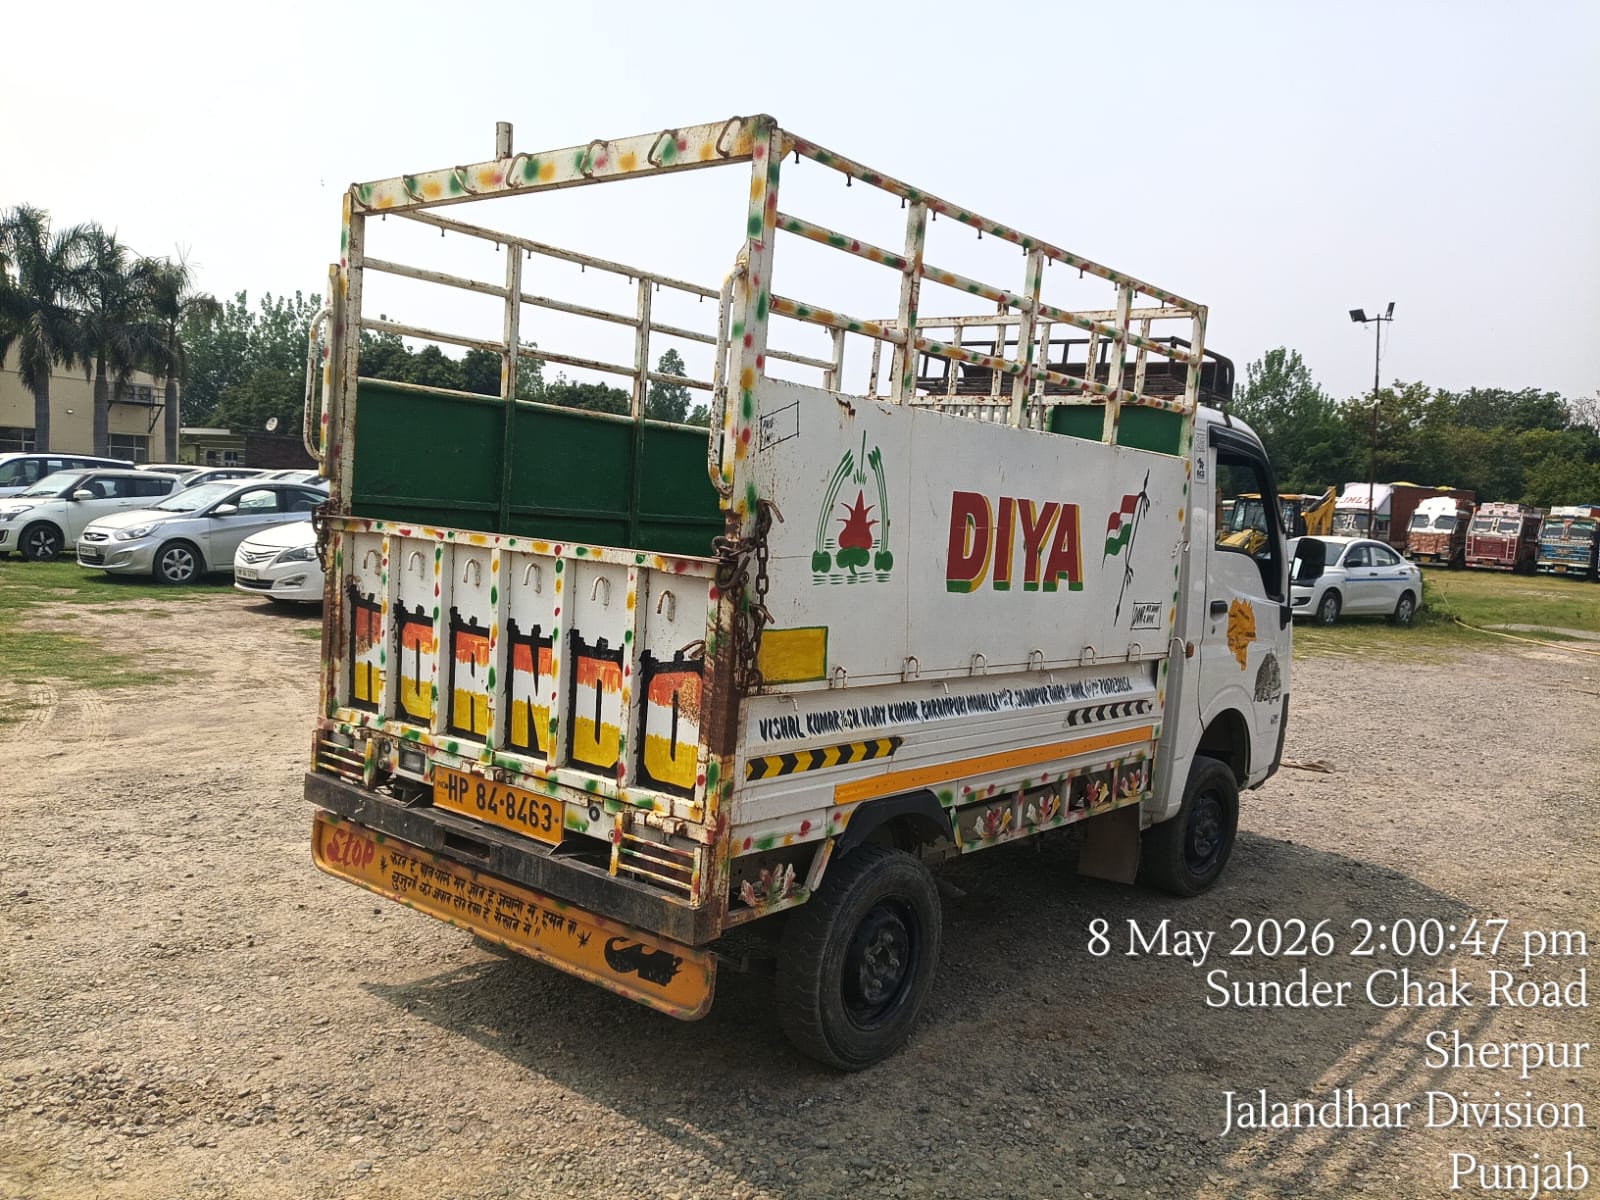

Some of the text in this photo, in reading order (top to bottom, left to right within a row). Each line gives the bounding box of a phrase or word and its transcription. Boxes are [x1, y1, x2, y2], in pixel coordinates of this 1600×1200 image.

[946, 490, 1084, 594] DIYA
[345, 583, 554, 762] HORN
[759, 714, 806, 742] VISHAL
[806, 709, 843, 736] KUMAR
[860, 704, 887, 728] VIJAY
[448, 772, 469, 804] HP
